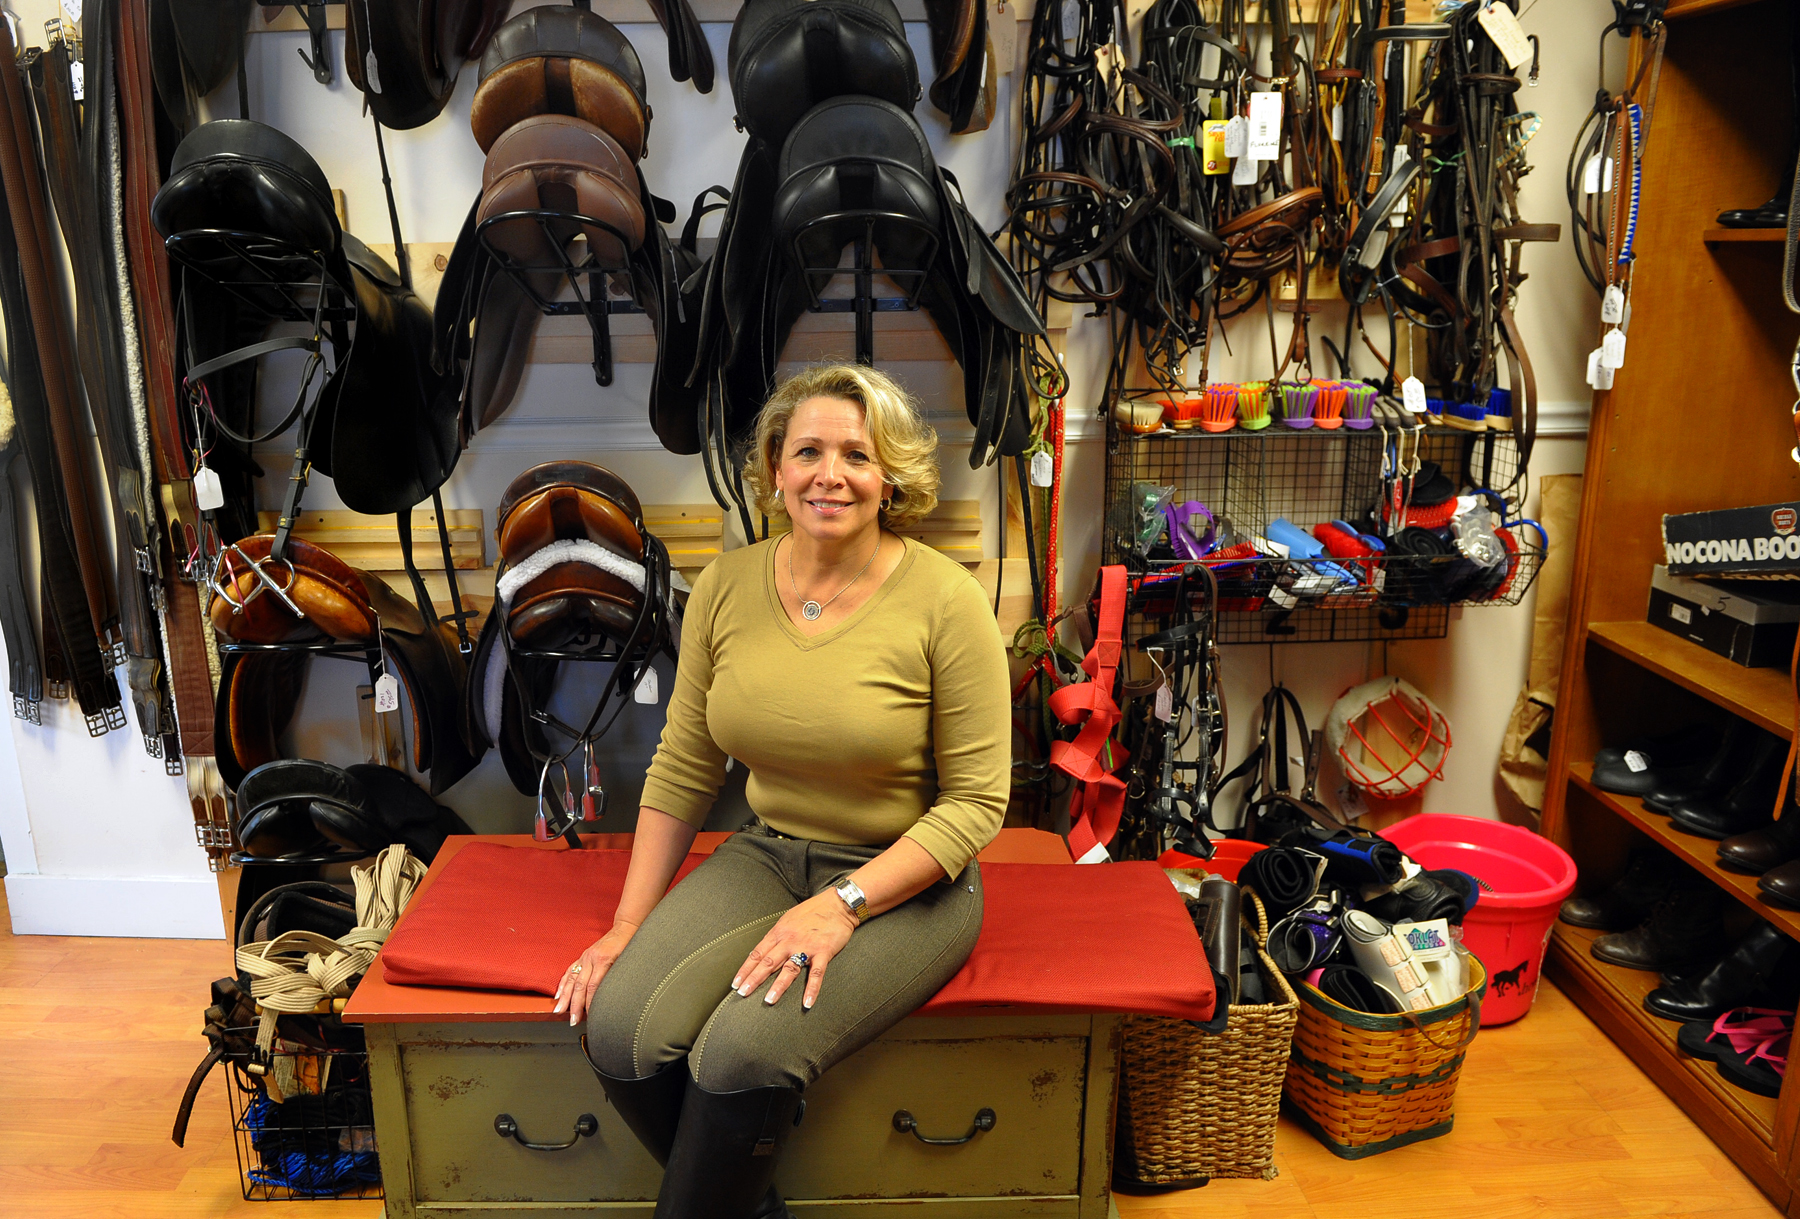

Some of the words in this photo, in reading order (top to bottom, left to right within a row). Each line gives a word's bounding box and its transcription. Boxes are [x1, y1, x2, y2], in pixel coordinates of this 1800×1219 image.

[1667, 539, 1754, 564] NOCONA
[1753, 535, 1800, 562] BOO
[1403, 928, 1439, 944] OKLAT
